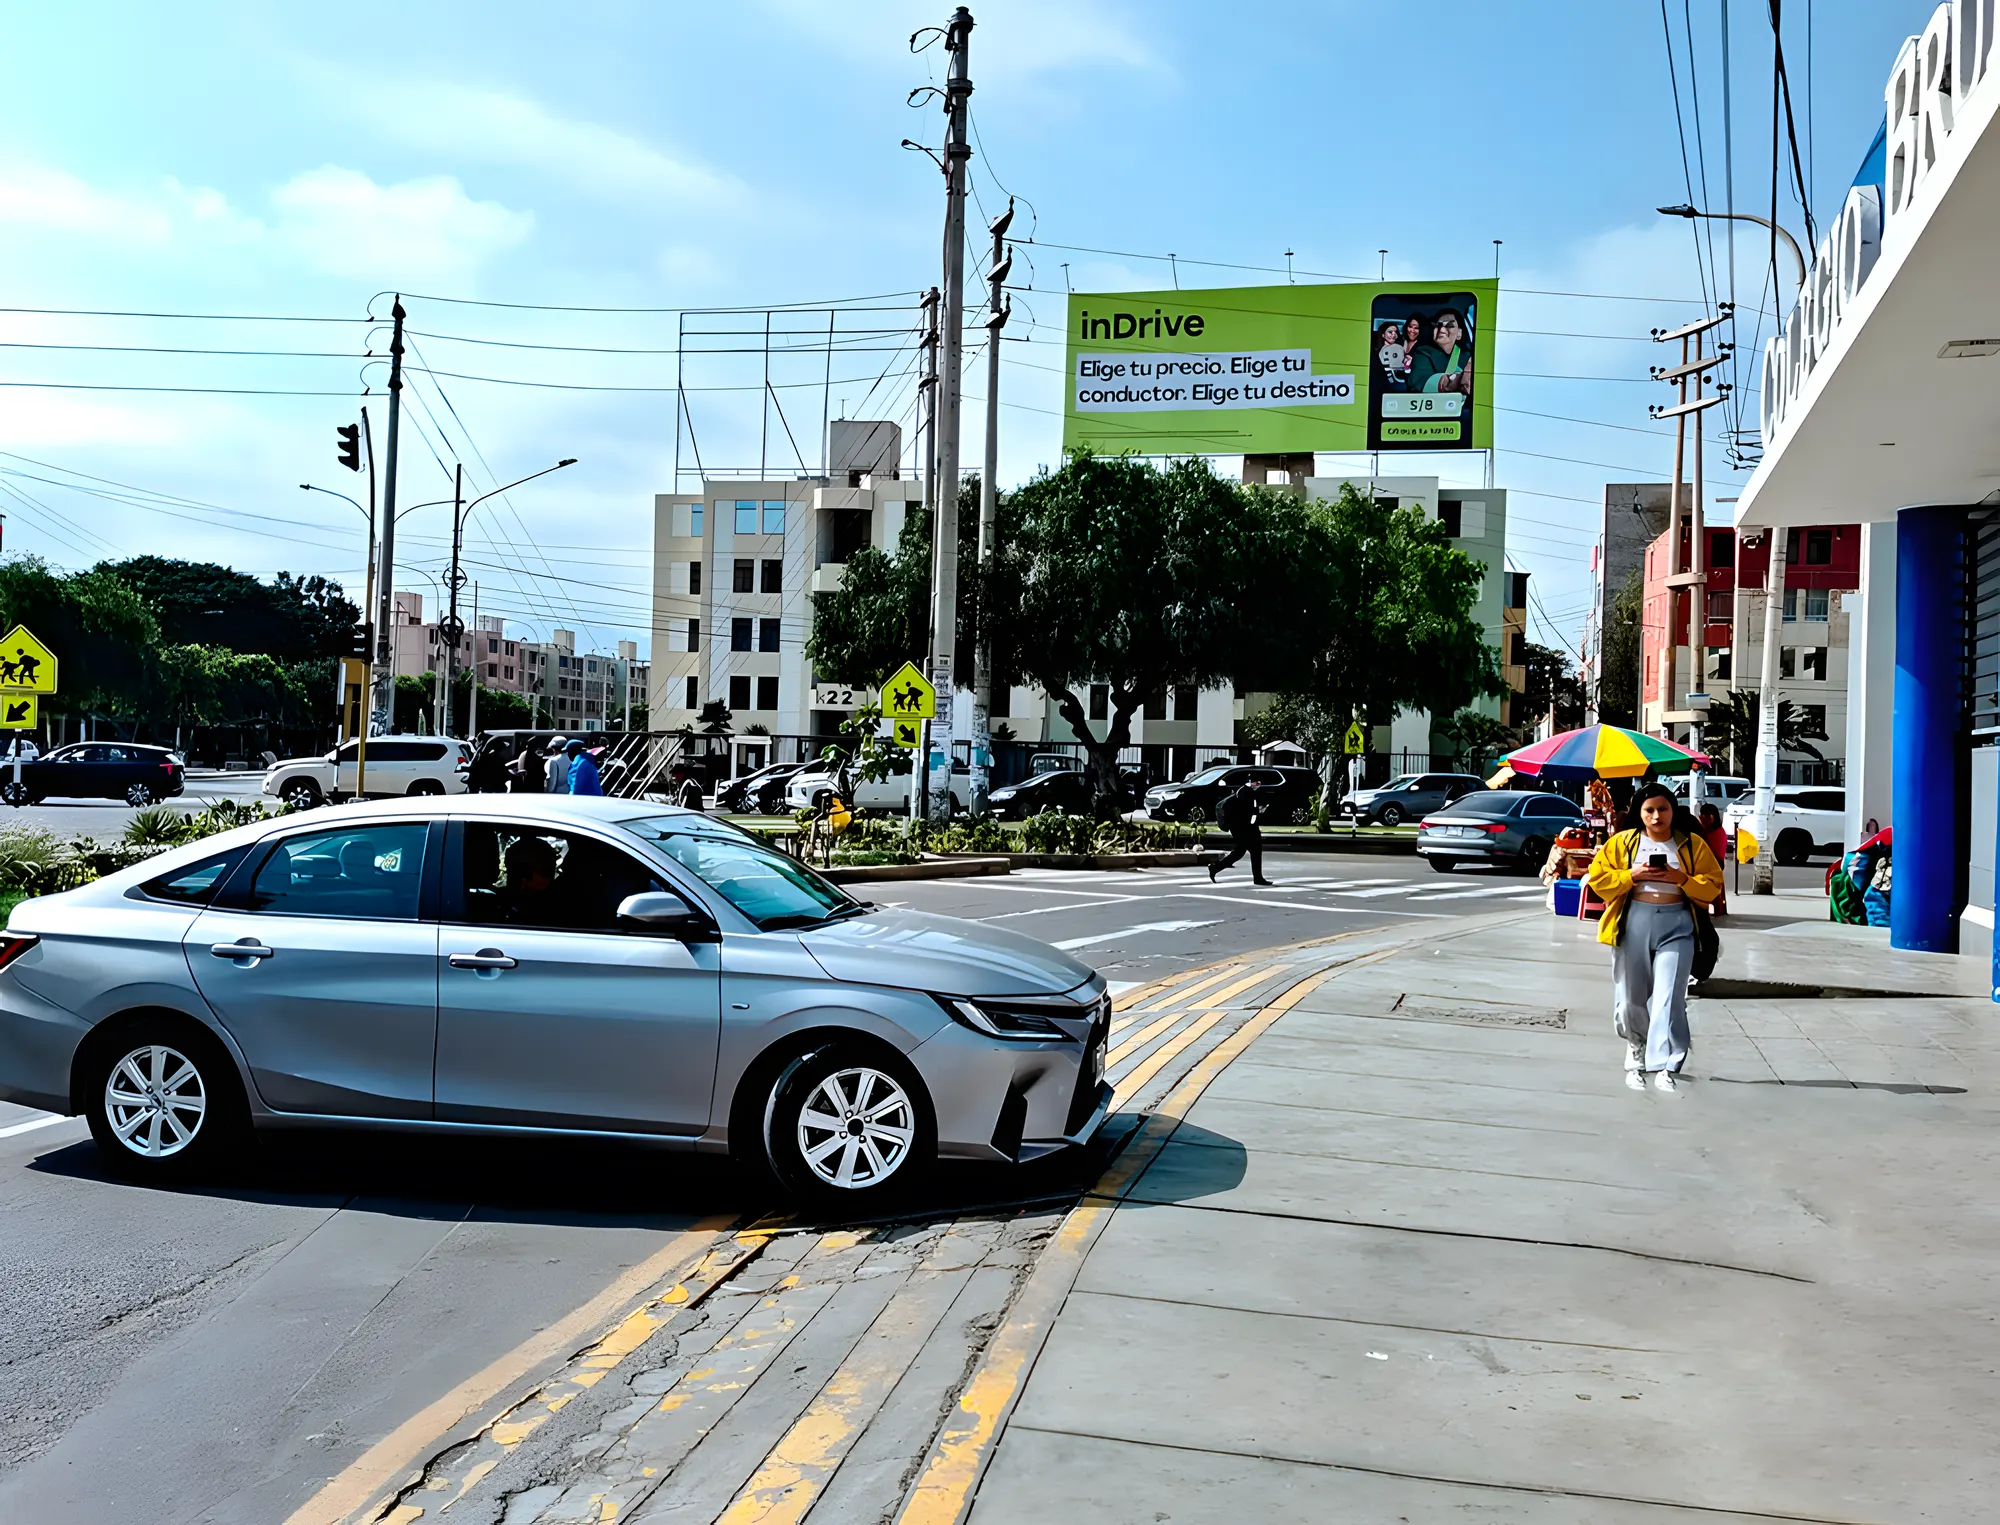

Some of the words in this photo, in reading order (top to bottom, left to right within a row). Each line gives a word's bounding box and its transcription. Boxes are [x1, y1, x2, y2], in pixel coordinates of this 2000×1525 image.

[1081, 308, 1205, 340] inDrive
[1759, 184, 1882, 454] COLEGIO
[1080, 360, 1126, 382] Elige
[1129, 361, 1152, 376] tu
[1156, 357, 1226, 380] precio.
[1230, 356, 1278, 378] Elige
[1281, 355, 1306, 372] tu
[1079, 385, 1187, 403] conductor.
[1192, 383, 1239, 405] Elige
[1243, 384, 1266, 400] tu
[1270, 380, 1350, 399] destino
[1409, 399, 1434, 412] S/8
